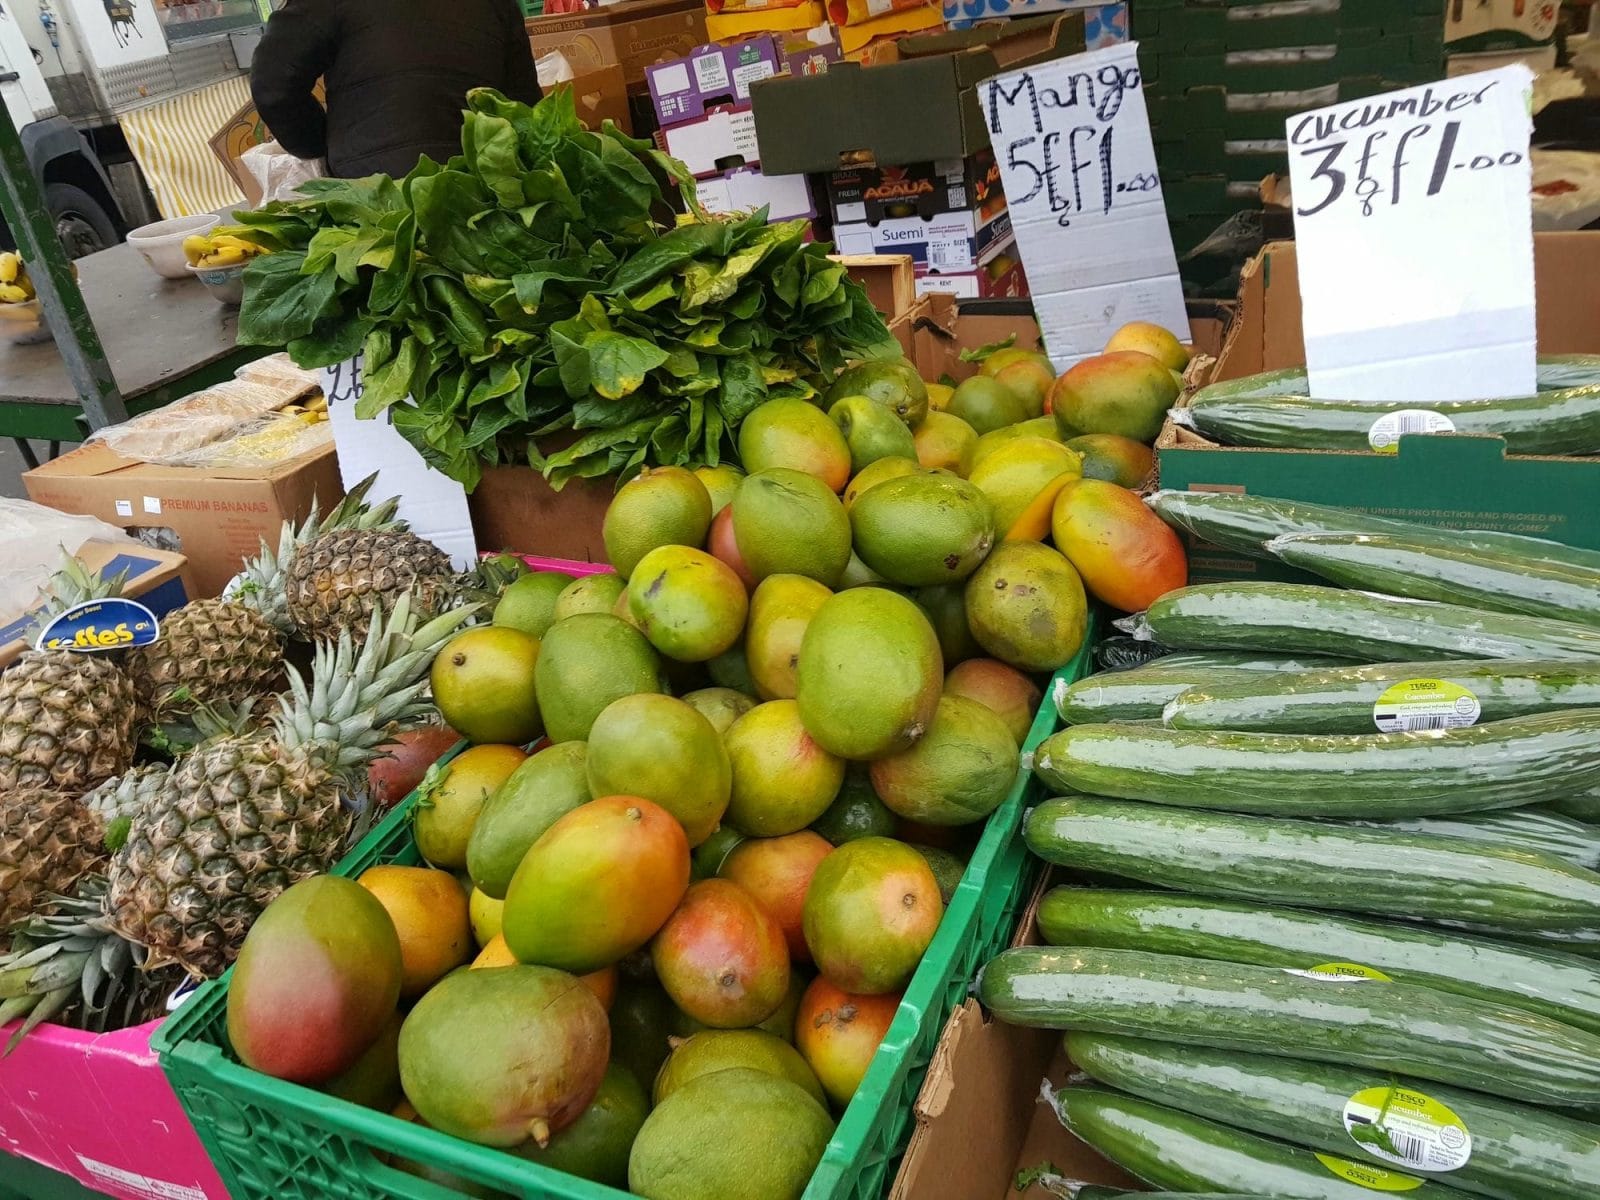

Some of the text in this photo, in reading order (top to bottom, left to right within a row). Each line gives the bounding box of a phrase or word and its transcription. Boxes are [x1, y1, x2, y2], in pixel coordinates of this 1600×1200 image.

[988, 64, 1141, 134] Mango
[882, 226, 924, 241] Suemi
[161, 498, 269, 513] PREMIUM BANANAS
[1370, 506, 1405, 517] UNDER
[1406, 508, 1474, 520] PROTECTION
[1475, 511, 1501, 521] AND
[1502, 512, 1547, 522] PACKED
[1408, 682, 1437, 690] TESCO
[1336, 966, 1366, 976] TESCO
[1394, 1091, 1426, 1107] TESCO
[1391, 1104, 1433, 1120] ucumber
[1345, 1168, 1378, 1185] TESCO
